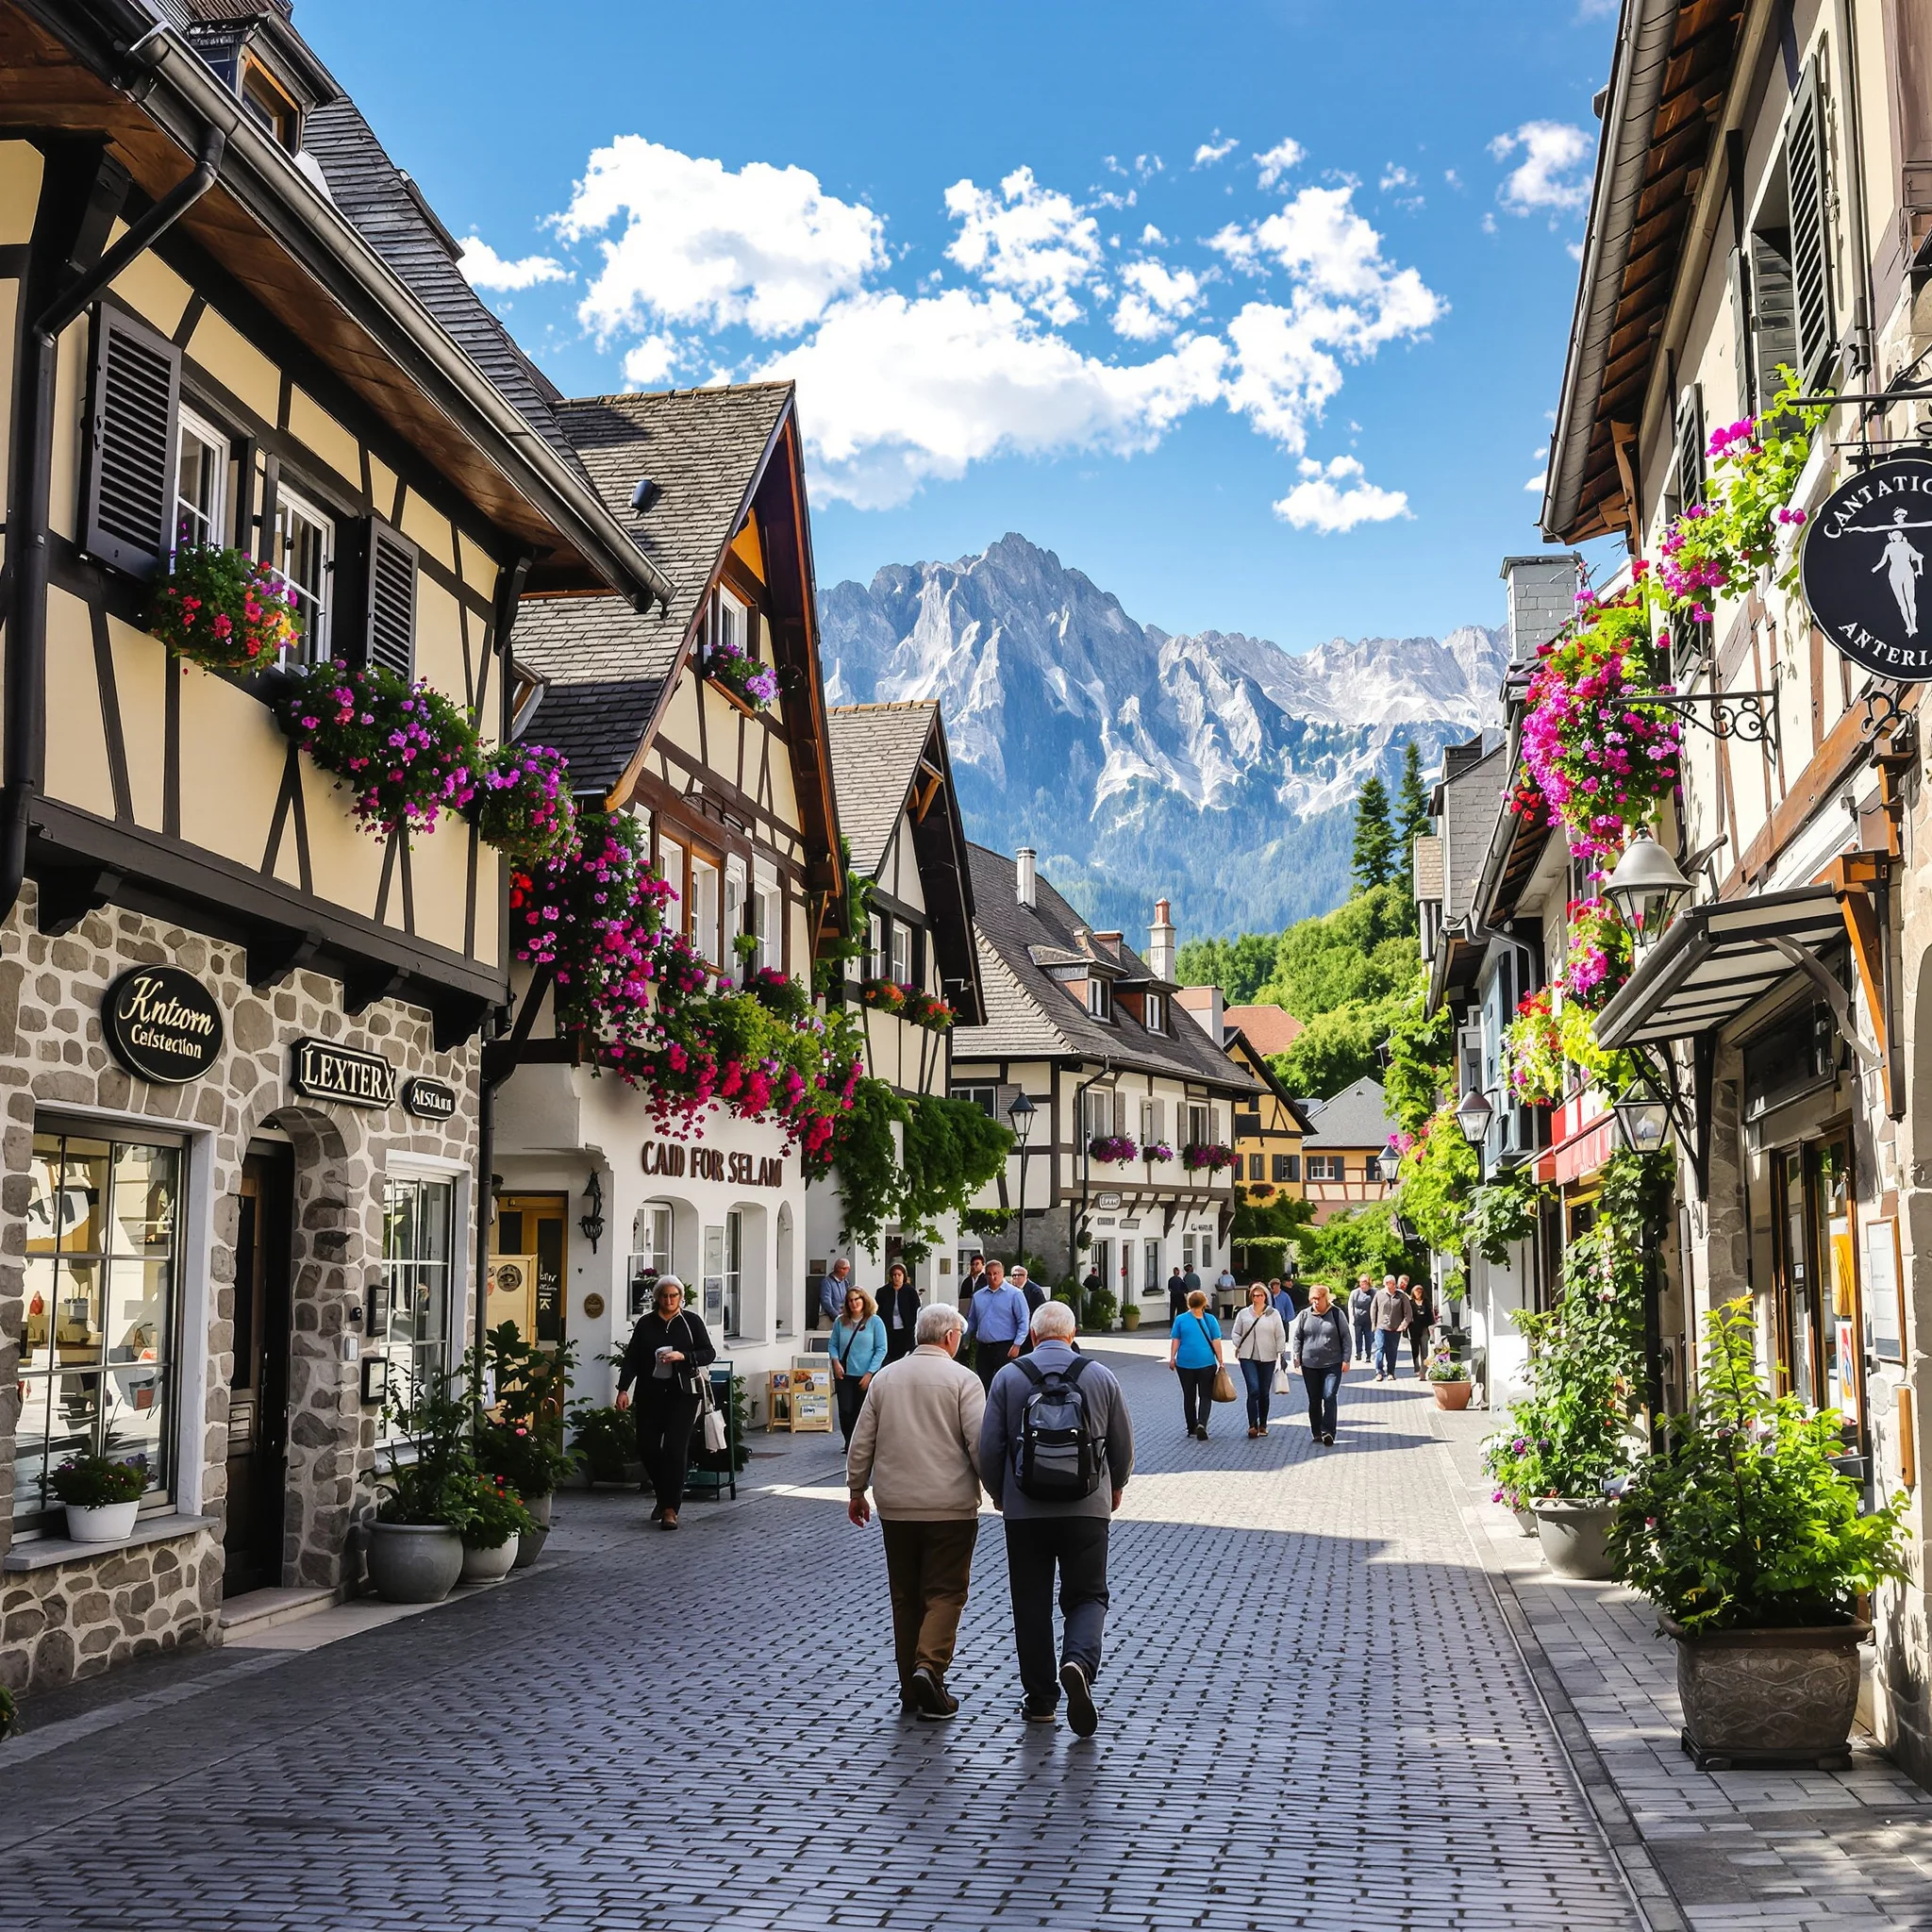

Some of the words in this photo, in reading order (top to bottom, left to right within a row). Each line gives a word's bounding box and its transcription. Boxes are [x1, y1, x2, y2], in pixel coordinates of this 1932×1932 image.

[1838, 622, 1932, 666] ANTERI
[304, 1050, 395, 1101] LEXTERX
[690, 1146, 724, 1181] FOR
